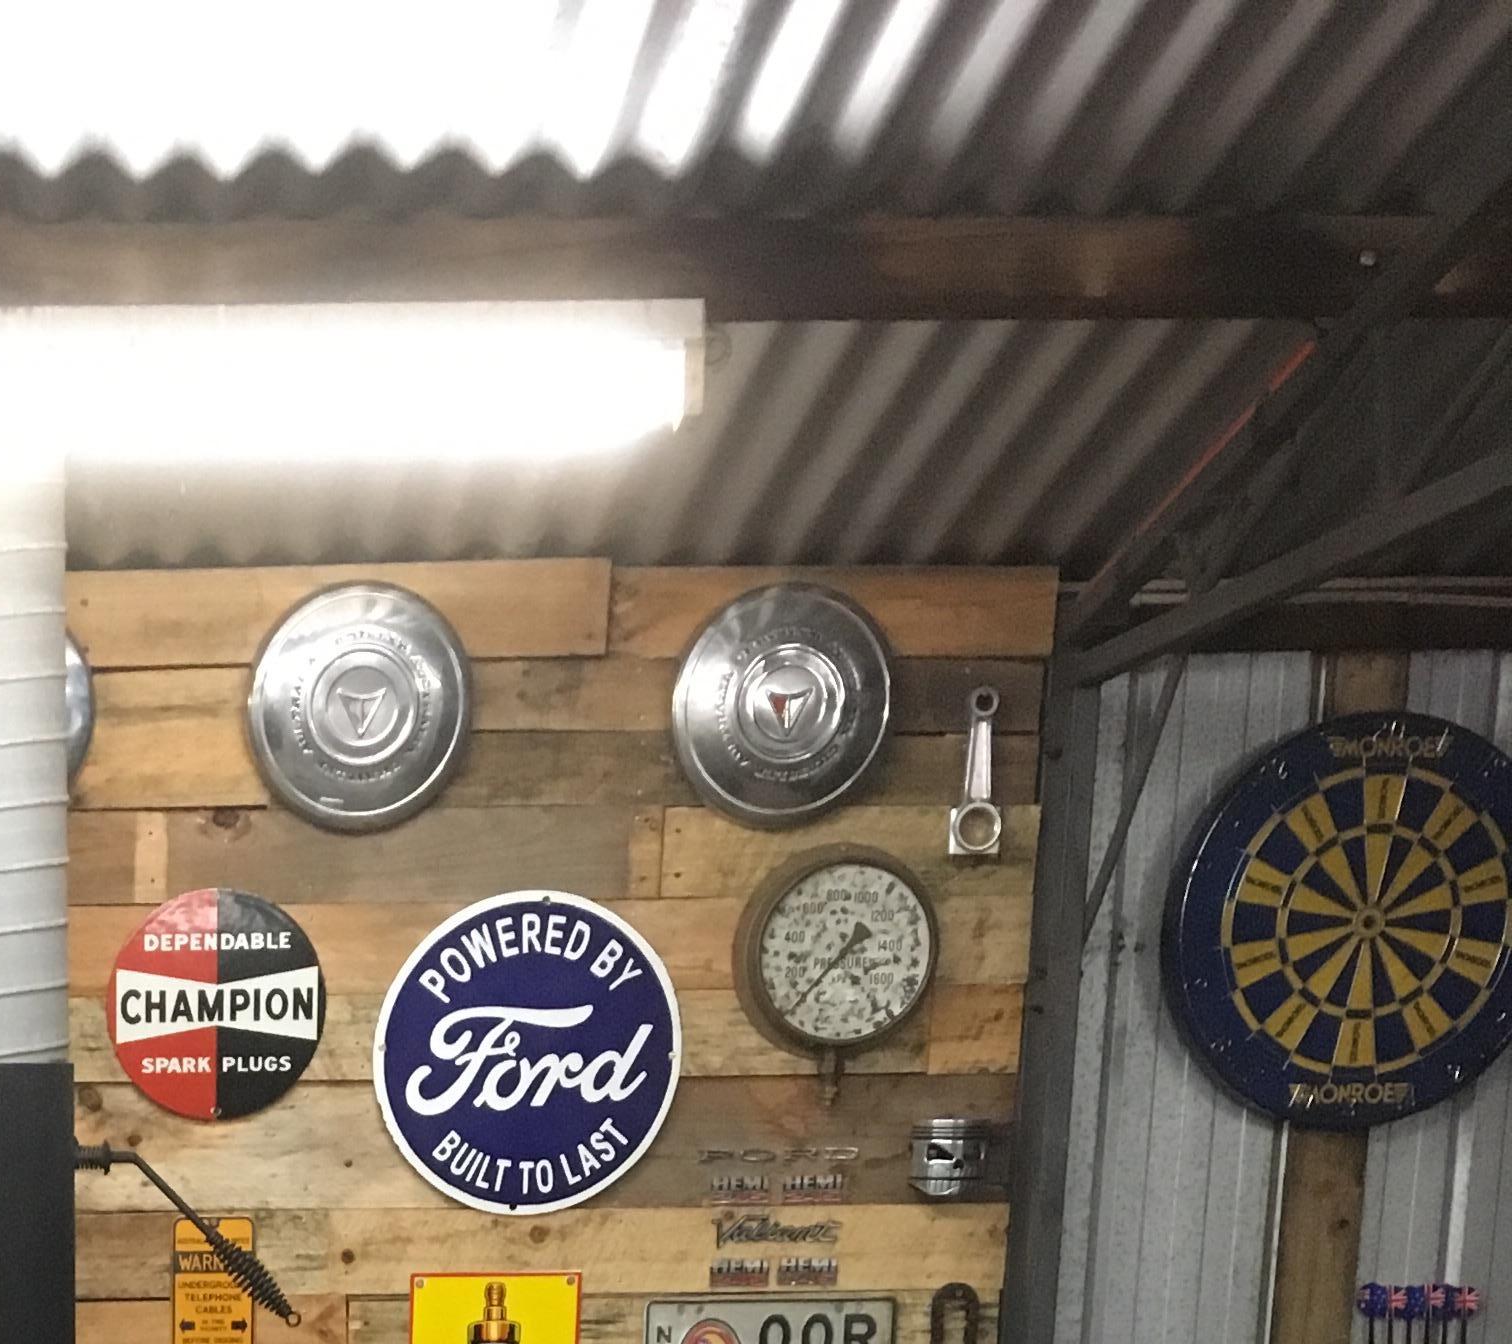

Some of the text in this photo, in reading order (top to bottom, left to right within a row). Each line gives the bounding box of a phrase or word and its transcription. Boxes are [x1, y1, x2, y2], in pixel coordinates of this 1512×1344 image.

[871, 910, 895, 922] 1200
[144, 932, 291, 952] DEPENDABLE
[418, 912, 643, 1004] POWERED BY
[120, 987, 313, 1025] CHAMPION
[141, 1056, 291, 1073] SPARK PLUGS
[405, 1004, 654, 1116] Ford
[432, 1117, 629, 1194] BUILT TO LAST
[784, 1174, 843, 1192] HEMI
[178, 1254, 225, 1271] WARN
[185, 1293, 242, 1301] TELEPHONE
[195, 1306, 232, 1314] CABLES
